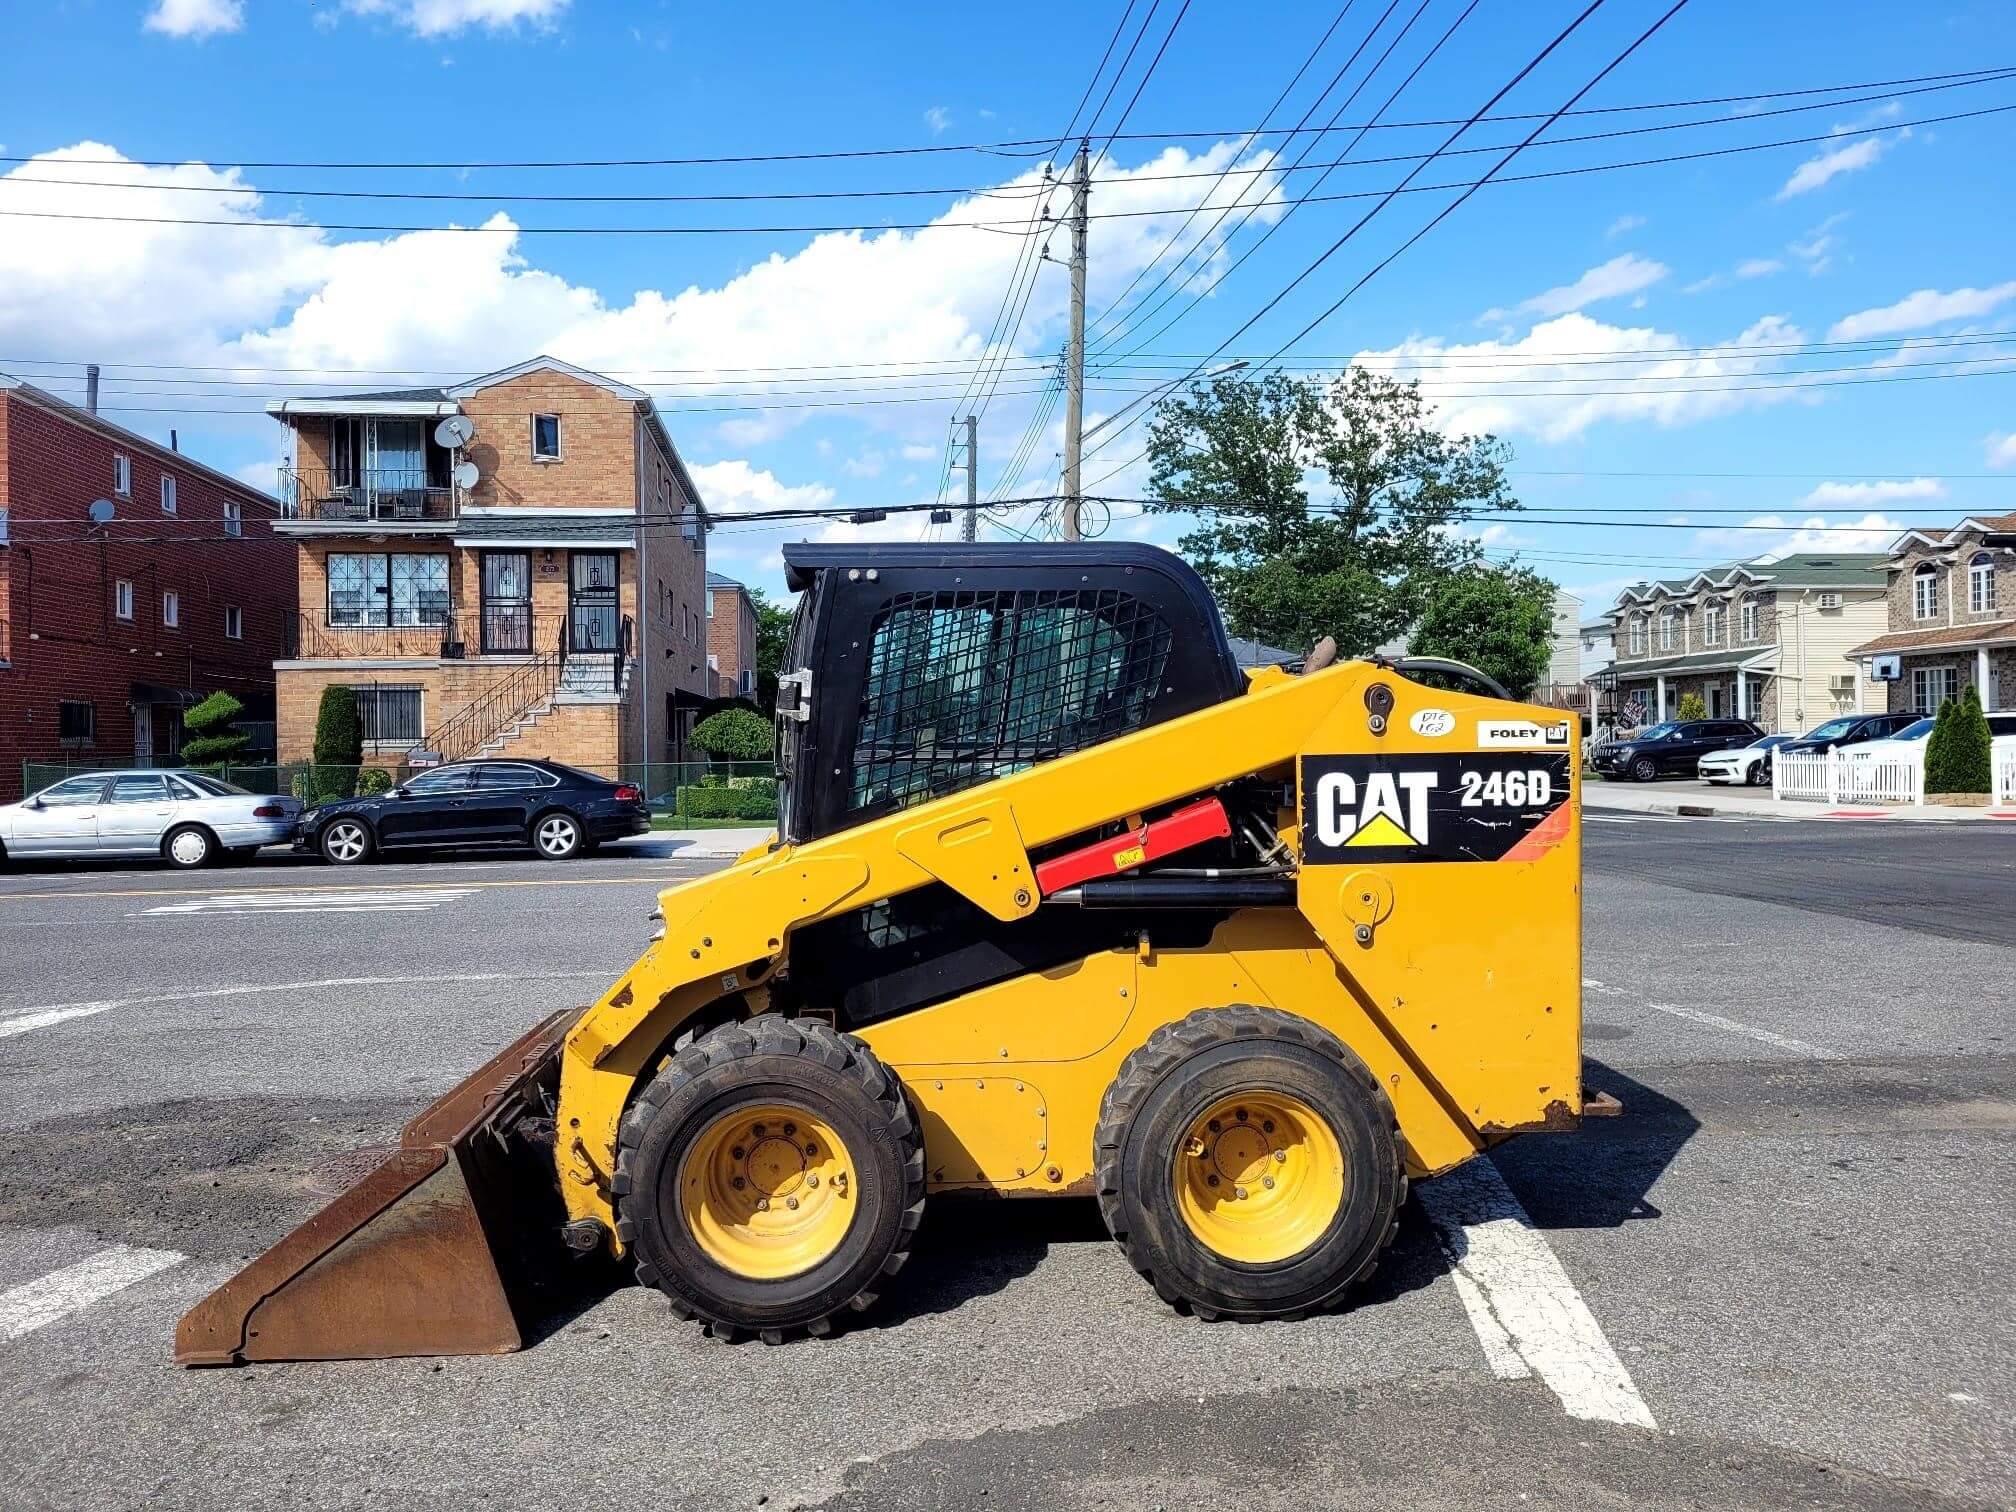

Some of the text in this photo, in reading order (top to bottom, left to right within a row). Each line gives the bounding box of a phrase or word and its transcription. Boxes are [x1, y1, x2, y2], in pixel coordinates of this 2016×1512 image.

[1490, 729, 1539, 738] FOLEY
[1317, 770, 1551, 847] CAT 246D
